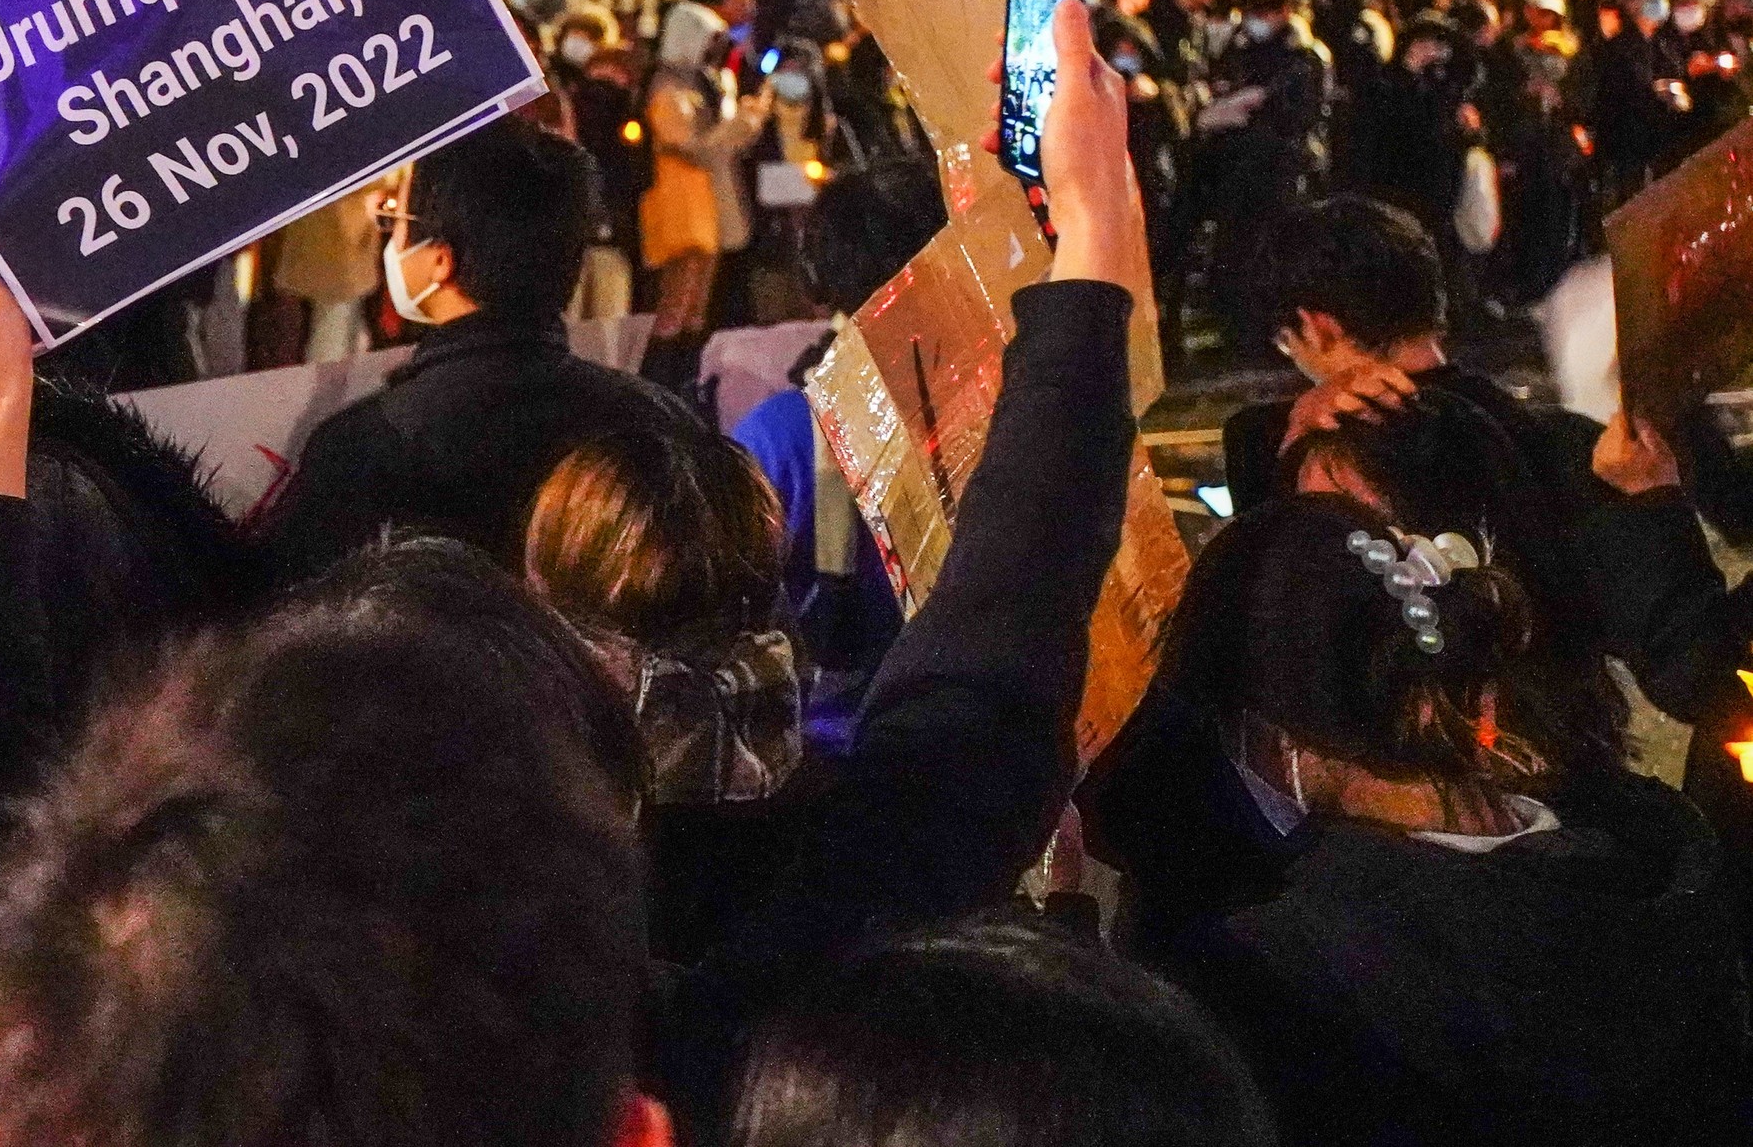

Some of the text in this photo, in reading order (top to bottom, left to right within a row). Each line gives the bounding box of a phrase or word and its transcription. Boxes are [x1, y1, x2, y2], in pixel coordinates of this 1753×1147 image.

[57, 13, 452, 256] 26 Nov, 2022
